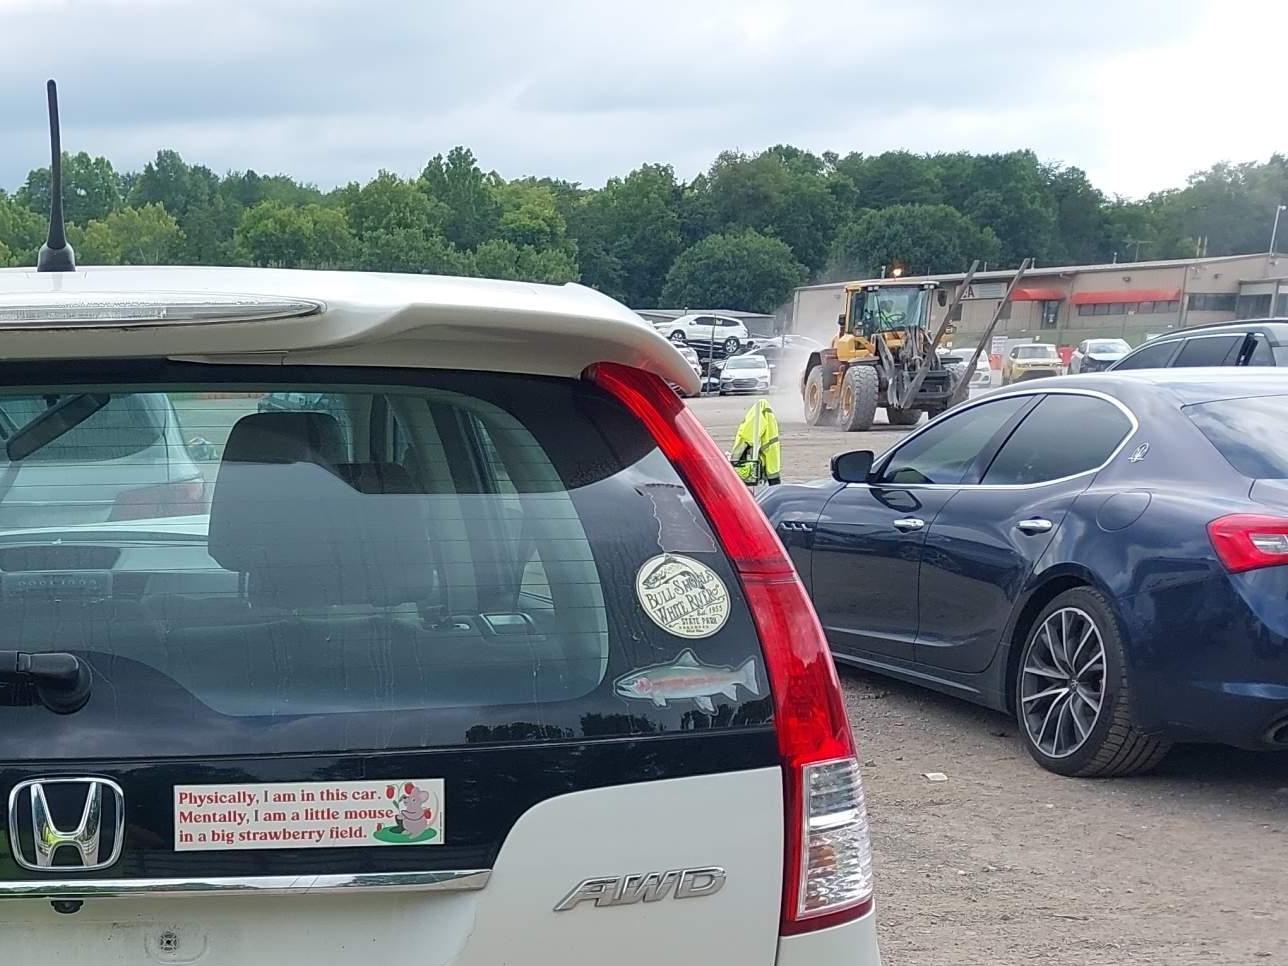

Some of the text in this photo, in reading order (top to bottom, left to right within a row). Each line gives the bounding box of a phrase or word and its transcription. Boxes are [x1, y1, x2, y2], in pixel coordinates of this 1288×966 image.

[646, 570, 714, 609] BULL SHOALS
[653, 601, 689, 624] WHITE
[681, 617, 700, 625] STATE
[178, 788, 382, 808] Physically, I am in this car.
[179, 808, 394, 824] Mentally, I am a little mouse
[179, 826, 368, 845] in a big strawberry field.
[553, 866, 727, 911] AWD
